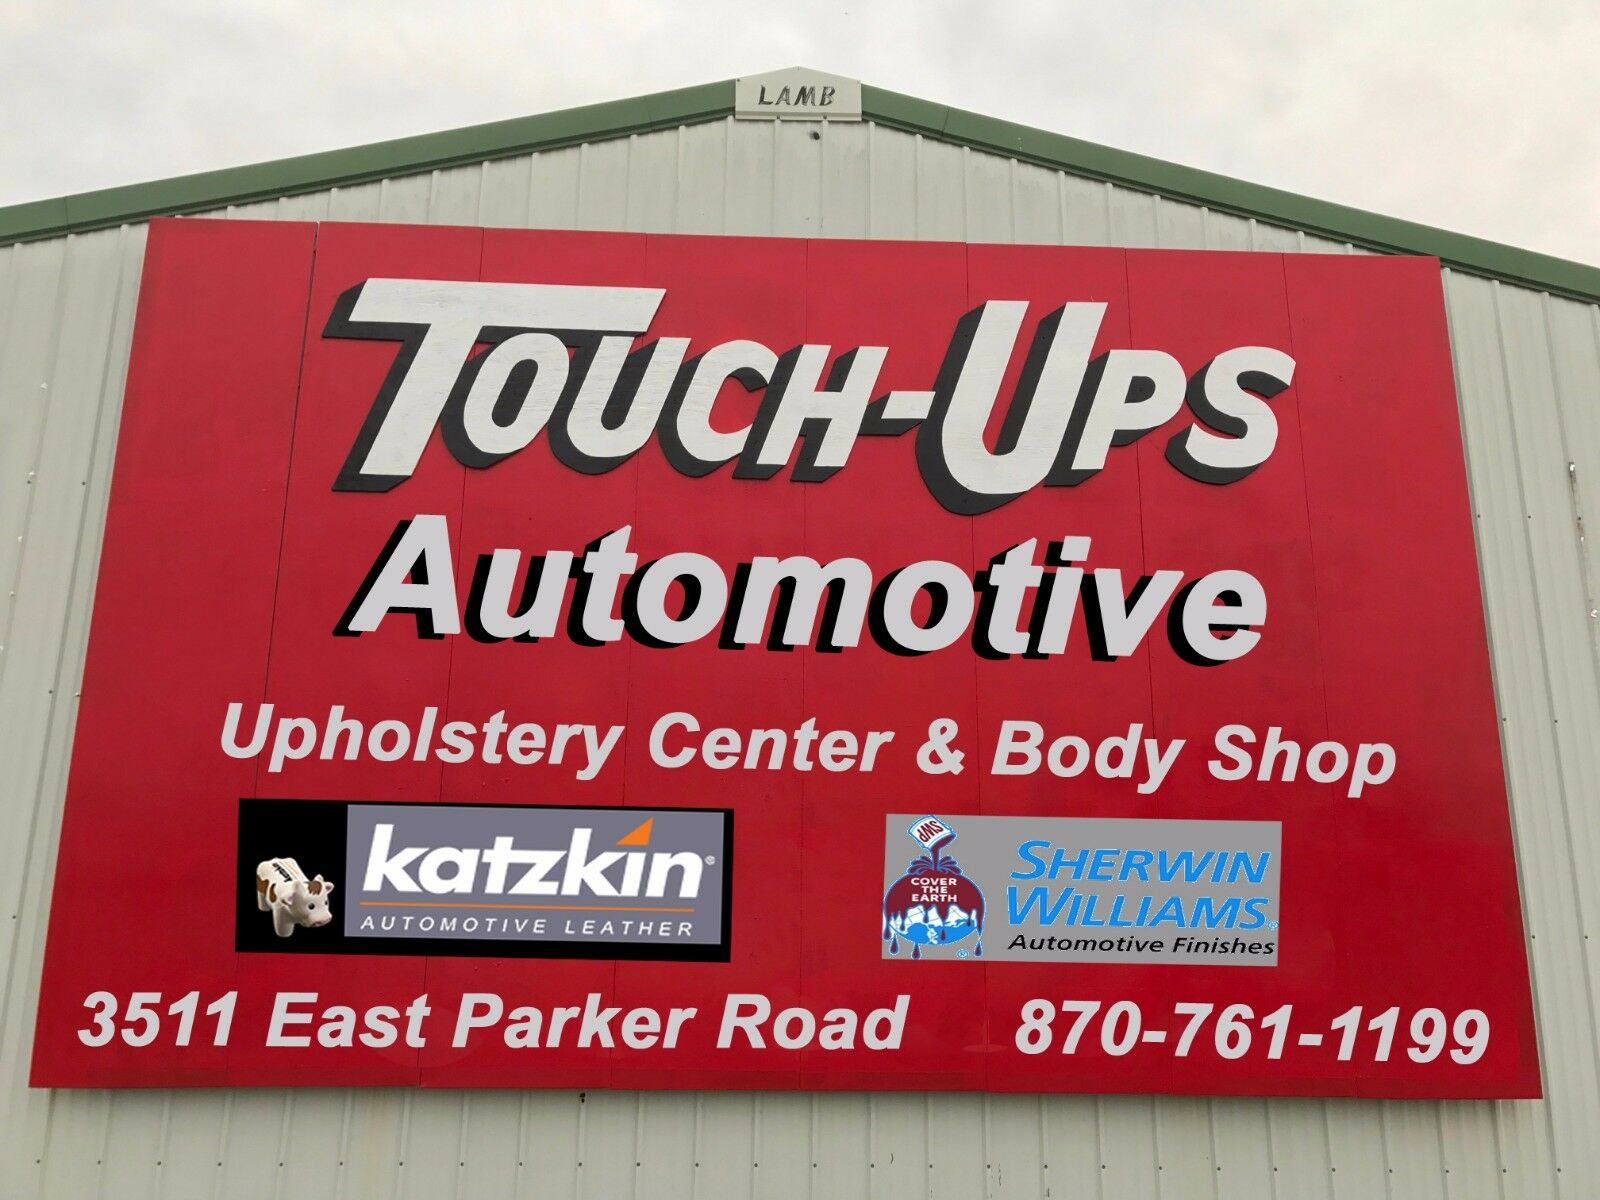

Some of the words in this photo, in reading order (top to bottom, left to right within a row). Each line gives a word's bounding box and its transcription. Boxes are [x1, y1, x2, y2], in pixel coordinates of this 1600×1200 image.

[758, 85, 835, 106] LAMB
[347, 278, 1297, 494] TOUCH-UPS
[346, 514, 1268, 661] Automotive
[220, 702, 625, 781] Upholstery
[649, 711, 896, 772] Center
[917, 717, 966, 776] &
[991, 719, 1186, 795] Body
[1207, 724, 1397, 799] Shop
[916, 820, 944, 843] SWP
[362, 817, 704, 899] katzkin
[1009, 839, 1272, 884] SHERWIN
[911, 877, 957, 886] COVER
[911, 893, 958, 903] EARTH
[921, 885, 948, 894] THE
[360, 916, 548, 934] AUTOMOTIVE
[564, 919, 694, 937] LEATHER
[1006, 885, 1271, 930] WILLIAMS
[1007, 933, 1165, 953] Automotive
[1171, 936, 1276, 955] Finishes
[77, 990, 238, 1047] 3511
[265, 991, 432, 1048] East
[451, 992, 698, 1050] Parker
[716, 993, 911, 1051] Road
[1015, 998, 1490, 1065] 870-761-1199
